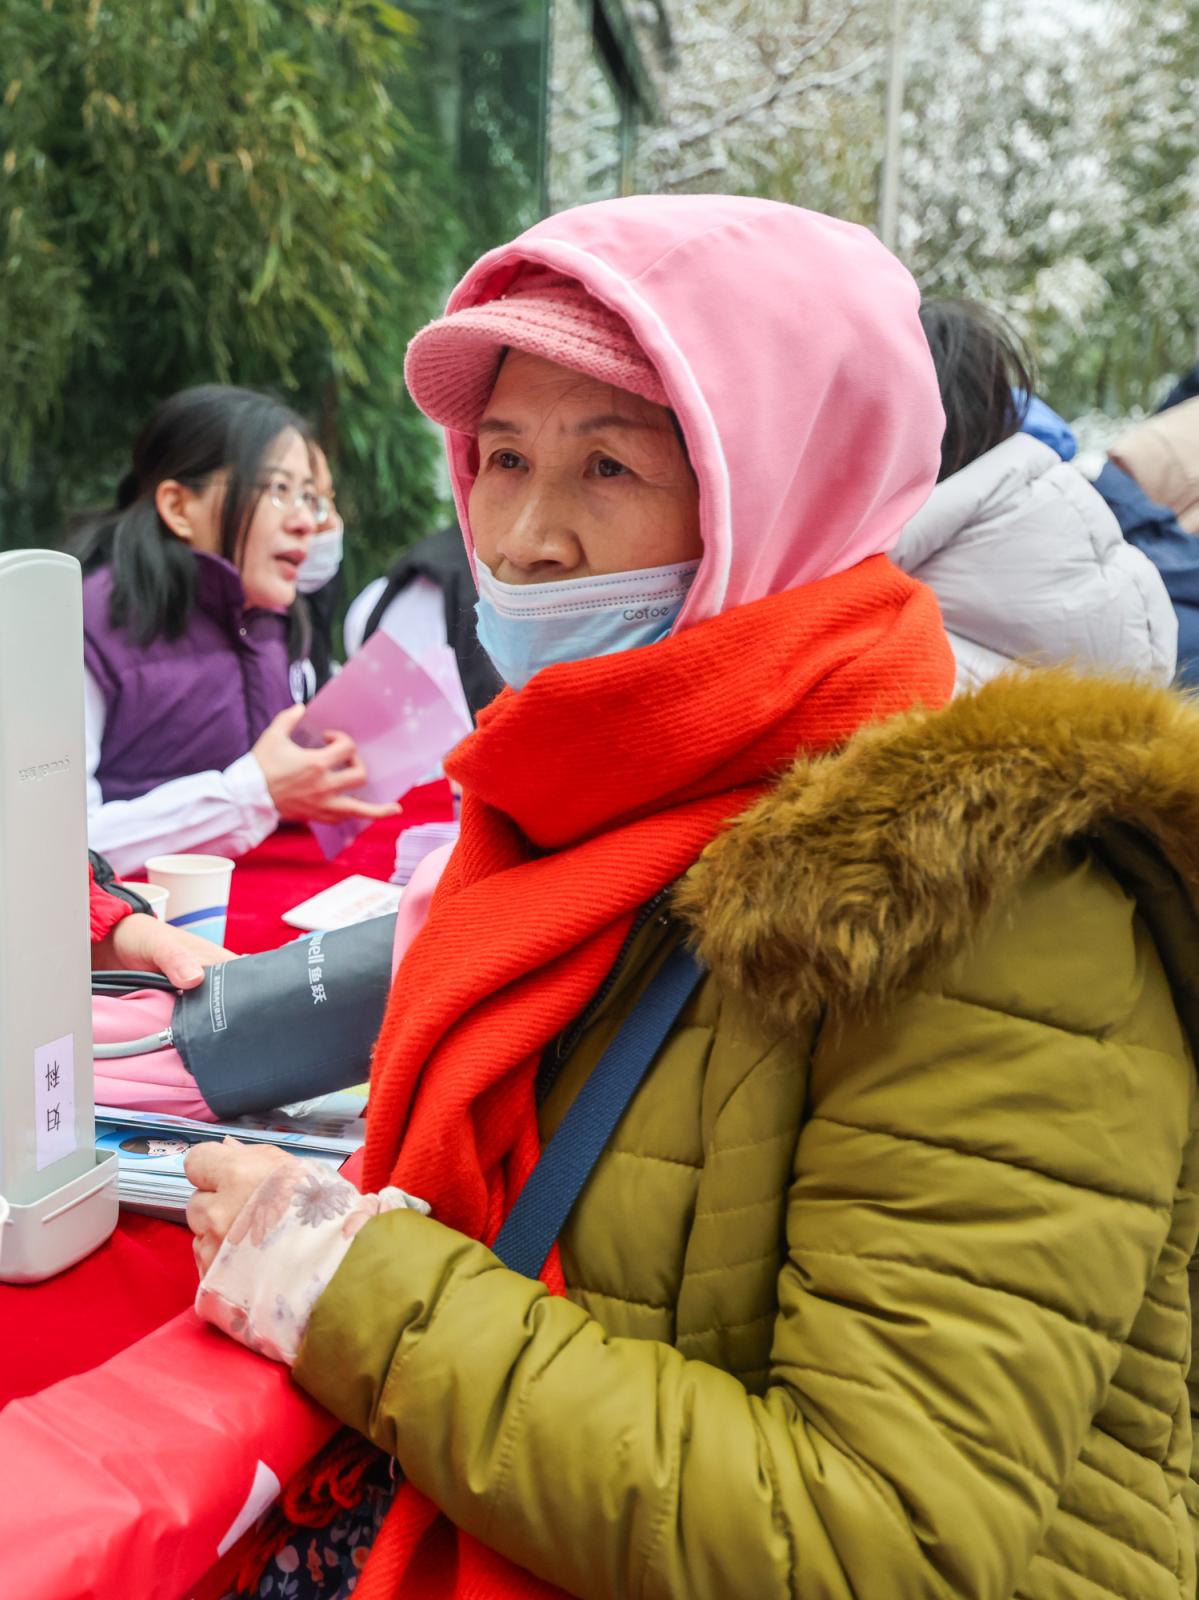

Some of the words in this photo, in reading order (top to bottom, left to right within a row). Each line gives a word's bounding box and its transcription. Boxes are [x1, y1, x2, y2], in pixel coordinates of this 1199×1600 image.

[622, 605, 670, 622] Cofoe
[308, 966, 328, 1005] 鱼跃
[44, 1060, 61, 1132] 妇科
